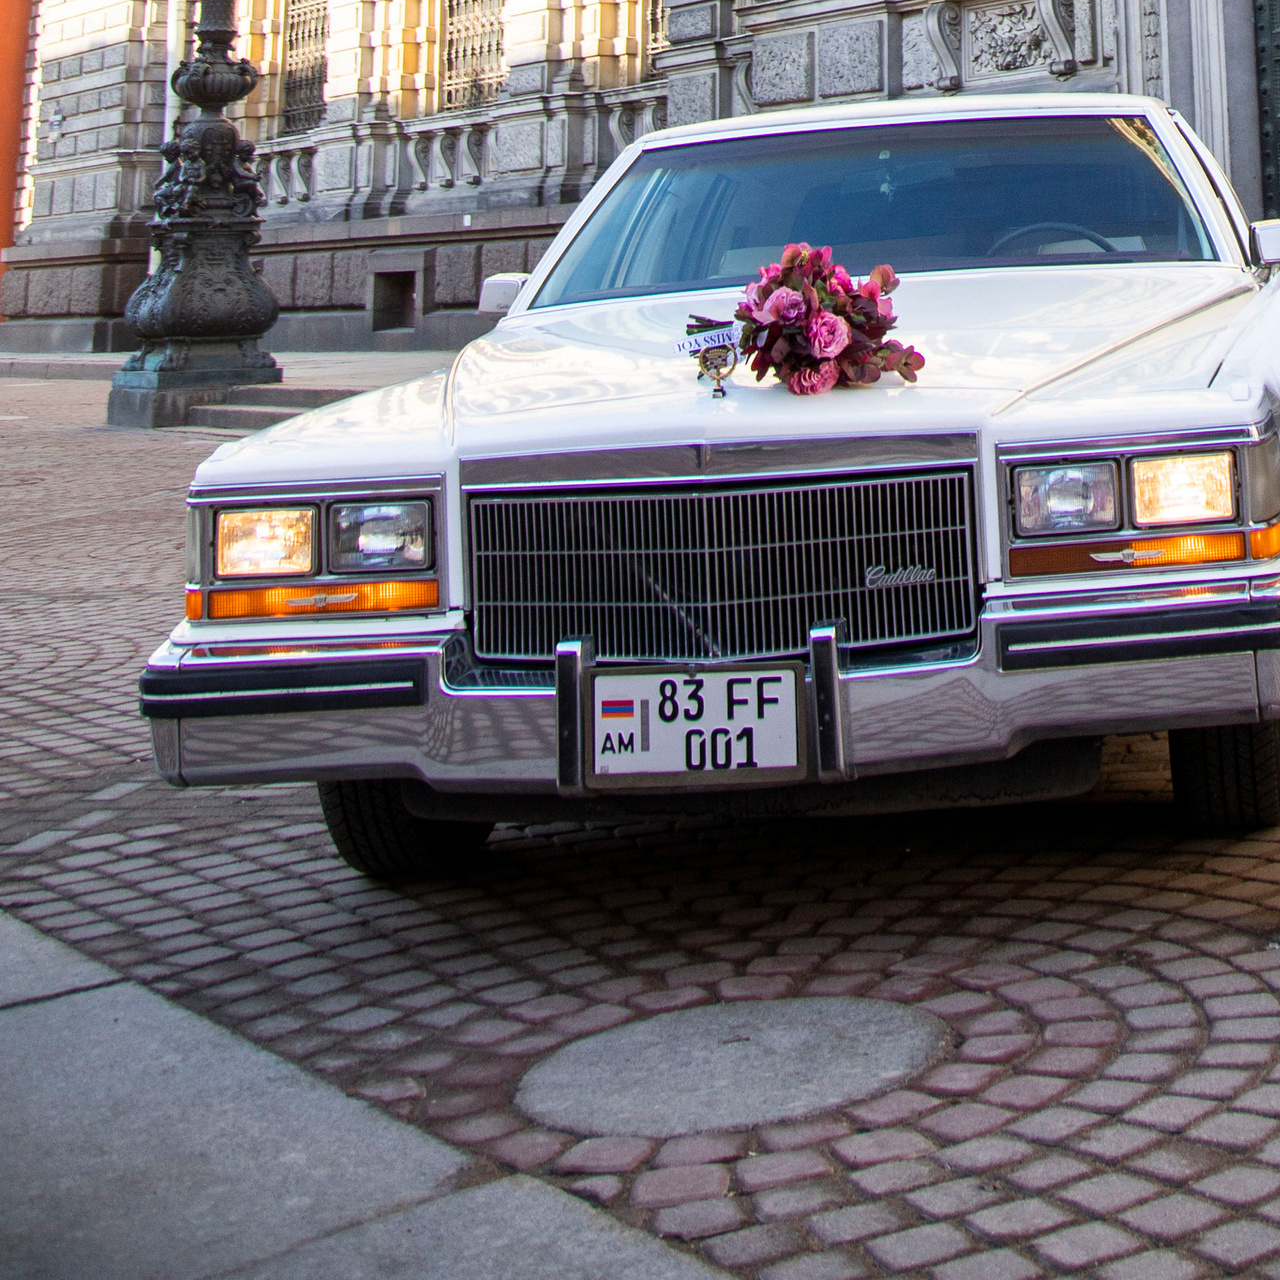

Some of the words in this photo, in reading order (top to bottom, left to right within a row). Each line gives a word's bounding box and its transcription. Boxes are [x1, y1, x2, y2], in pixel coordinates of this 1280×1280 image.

[703, 331, 732, 345] MISS
[865, 564, 936, 588] Cadillac
[658, 678, 704, 723] 83
[726, 676, 782, 721] FF
[601, 732, 635, 755] AM
[685, 726, 758, 771] 001
